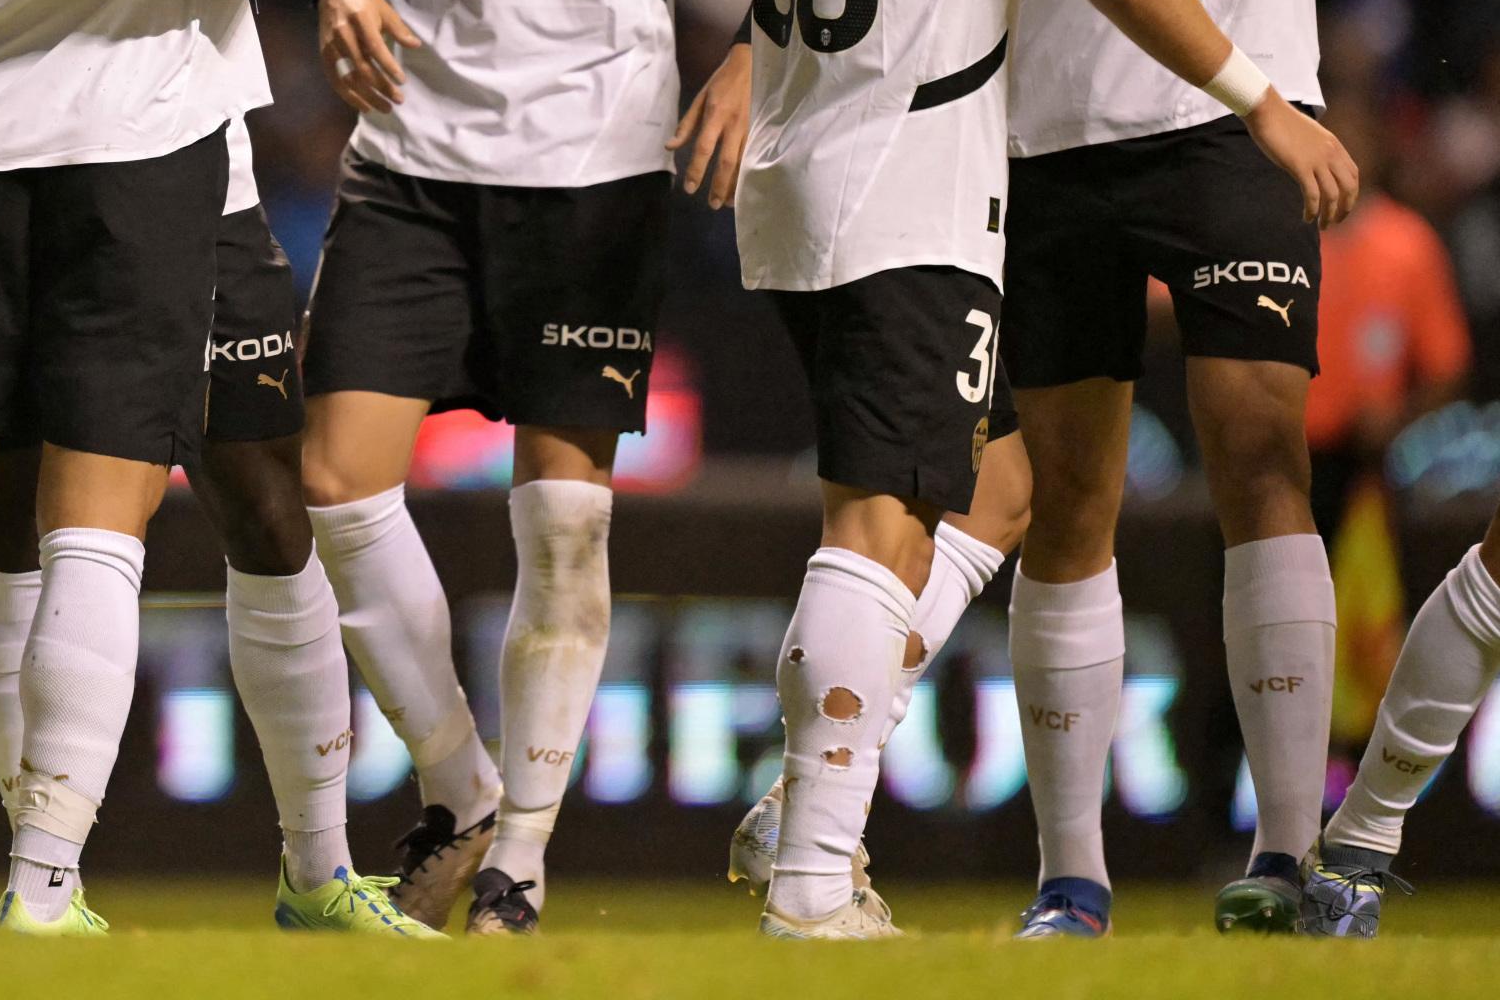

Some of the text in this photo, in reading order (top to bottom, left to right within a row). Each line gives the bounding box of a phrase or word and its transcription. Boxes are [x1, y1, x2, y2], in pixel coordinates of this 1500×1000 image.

[1192, 261, 1311, 289] SKODA
[541, 323, 652, 352] SKODA
[956, 308, 1000, 410] 3
[1250, 676, 1304, 695] VCF
[1028, 704, 1080, 732] VCF
[526, 746, 573, 767] VCF
[1382, 747, 1429, 775] VCF
